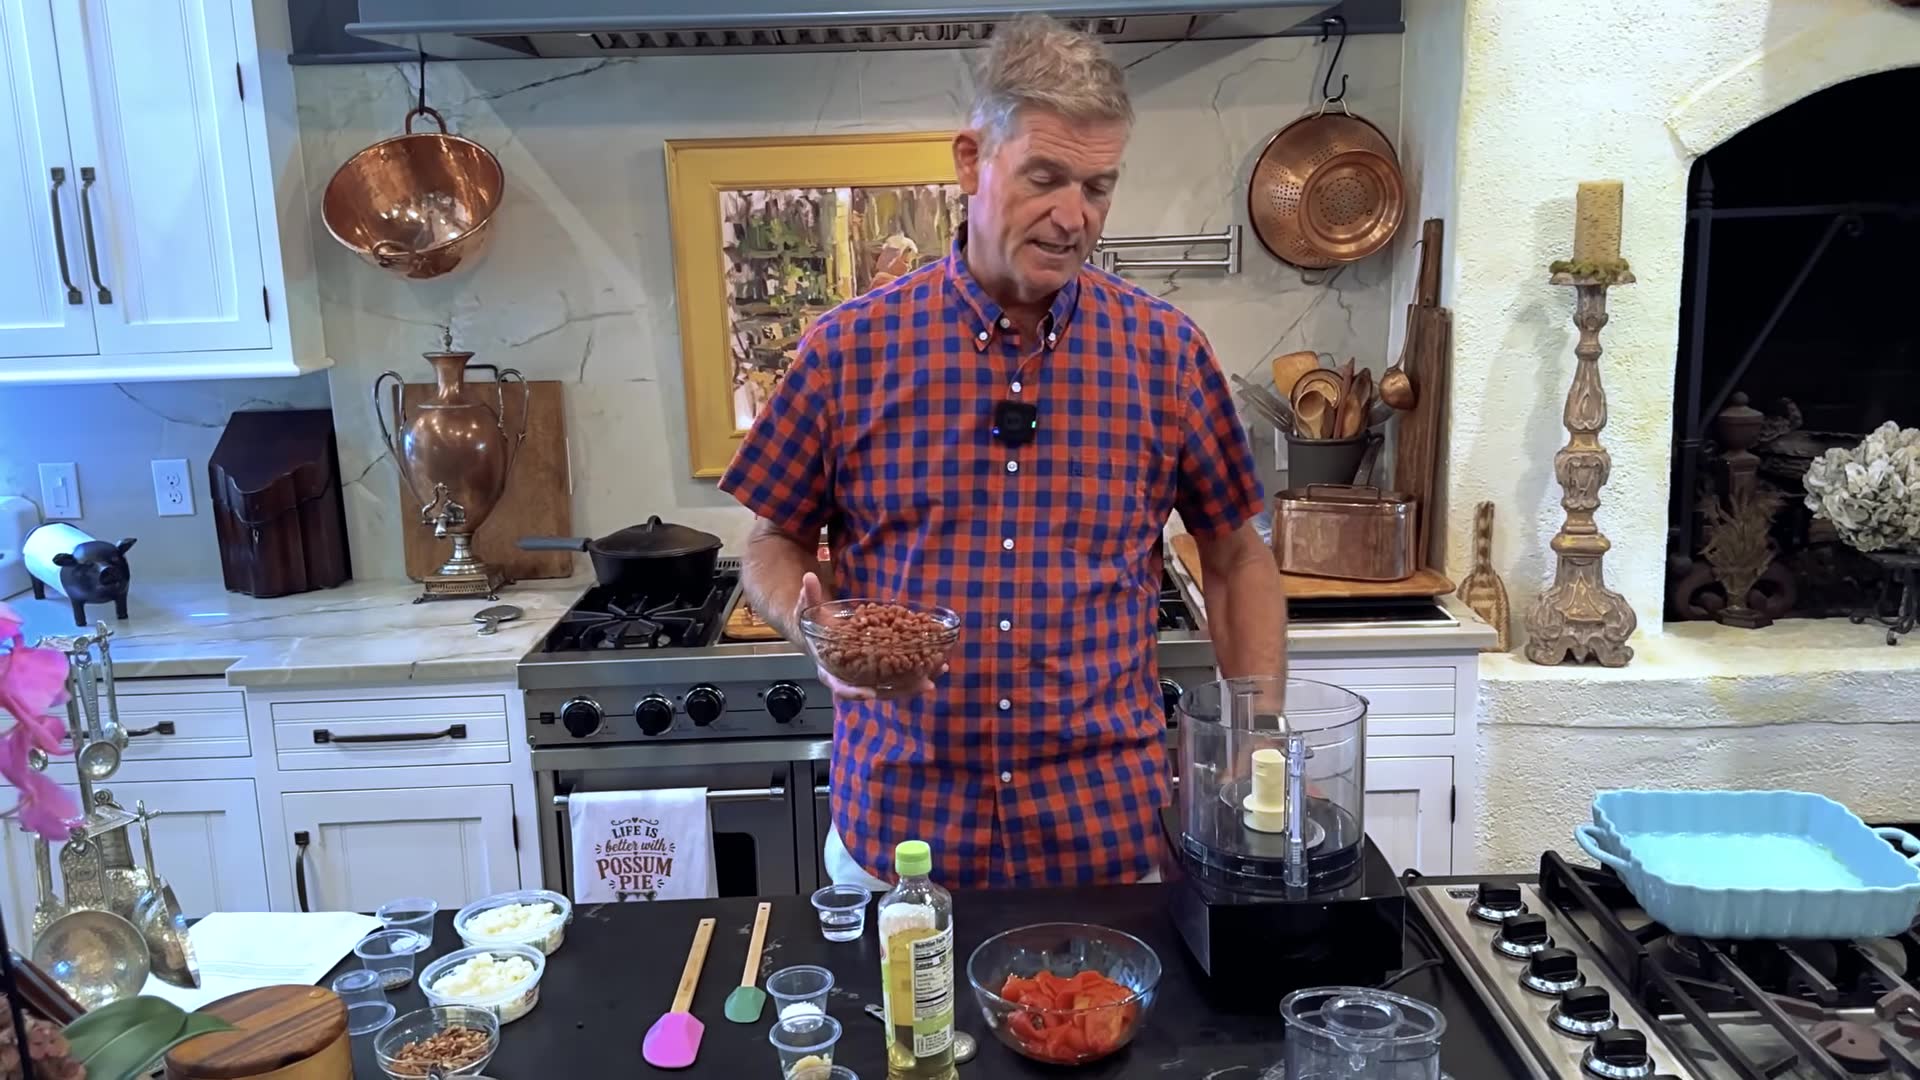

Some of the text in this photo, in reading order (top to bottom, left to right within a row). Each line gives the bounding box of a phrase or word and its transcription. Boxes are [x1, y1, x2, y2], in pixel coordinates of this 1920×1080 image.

[611, 826, 659, 839] LIFE IS
[605, 838, 667, 852] better with
[596, 856, 673, 880] POSSUM
[619, 875, 653, 890] PIE
